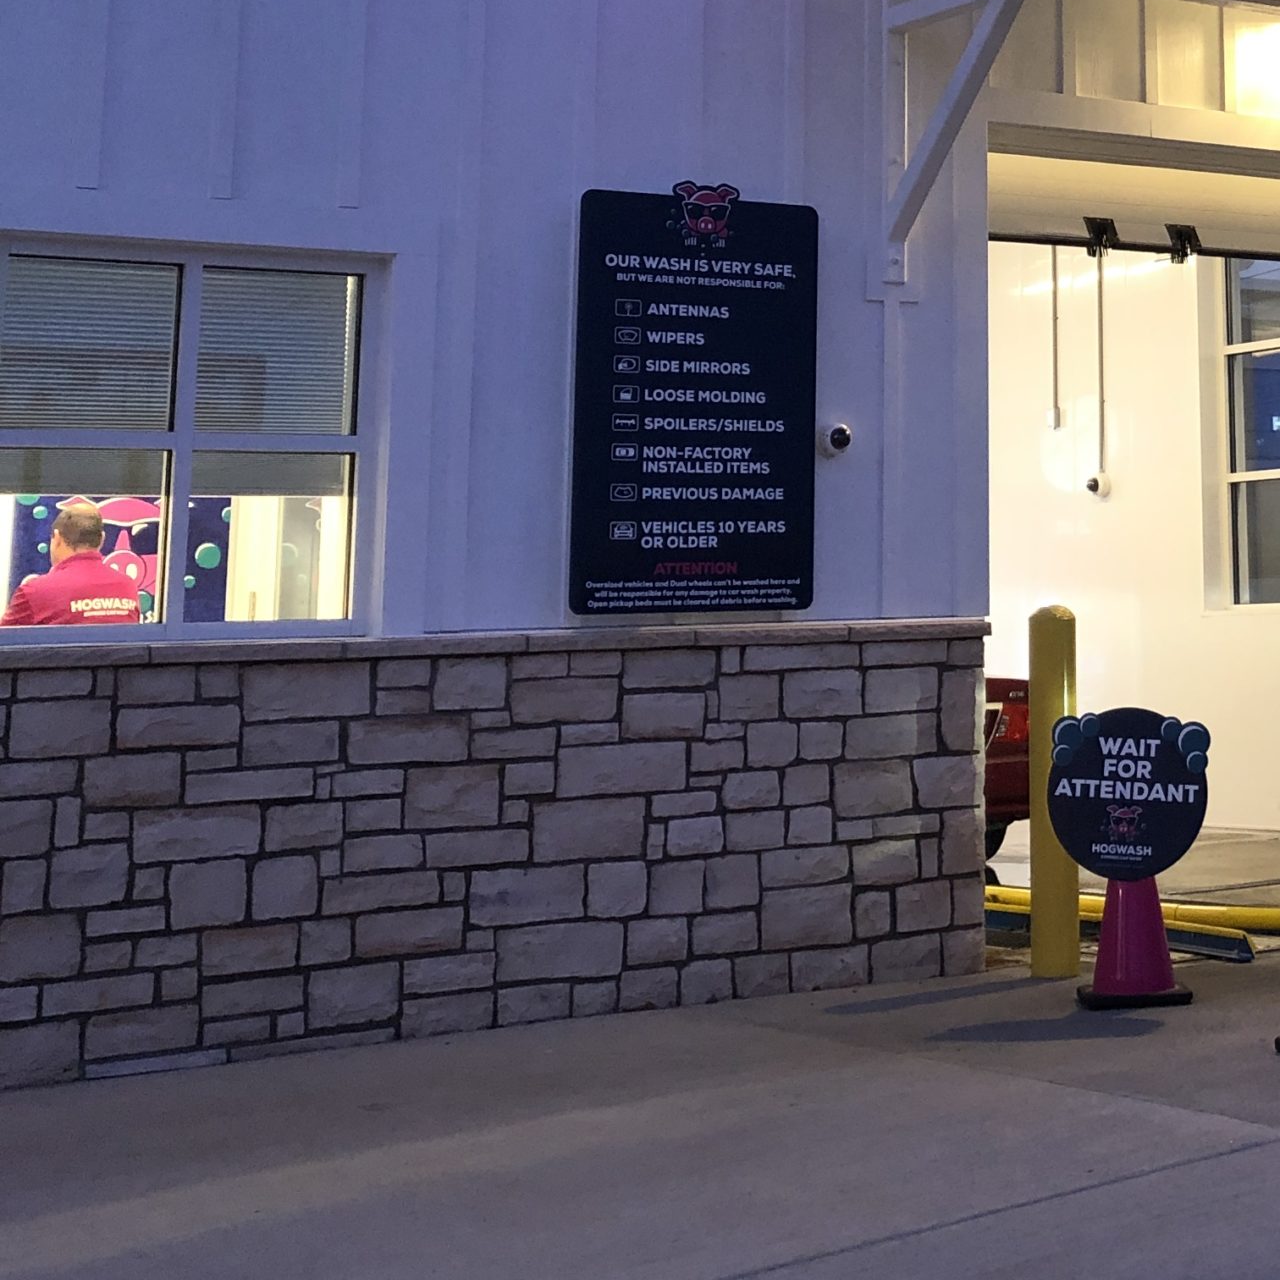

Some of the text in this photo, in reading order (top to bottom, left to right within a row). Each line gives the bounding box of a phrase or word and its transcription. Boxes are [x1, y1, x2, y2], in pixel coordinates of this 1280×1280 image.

[605, 253, 640, 268] OUR
[643, 255, 691, 271] WASH
[694, 259, 709, 272] IS
[711, 260, 752, 275] VERY
[616, 273, 635, 282] BUT
[638, 273, 653, 283] WE
[655, 274, 675, 284] ARE
[676, 275, 697, 285] NOT
[698, 277, 762, 289] RESPONSIBLE
[647, 303, 730, 318] ANTENNAS
[646, 330, 705, 345] WIPERS
[645, 359, 751, 375] SIDE MIRRORS
[644, 389, 767, 404] LOOSE MOLDING
[643, 417, 785, 432] SPOILERS/SHIELDS
[643, 446, 752, 460] NON-FACTORY
[642, 461, 770, 475] INSTALLED ITEMS
[642, 487, 784, 501] PREVIOUS DAMAGE
[641, 520, 786, 534] VEHICLES 10 YEARS
[641, 536, 718, 549] OR OLDER
[654, 561, 737, 575] ATTENTION
[624, 580, 653, 588] vehicles
[688, 579, 712, 587] wheels
[743, 578, 769, 586] washed
[787, 577, 800, 585] and
[620, 589, 661, 599] responsible
[675, 590, 688, 598] any
[689, 588, 718, 598] damage
[740, 587, 759, 595] wash
[70, 597, 137, 613] HOGWASH
[587, 600, 608, 609] Open
[609, 599, 634, 609] pickup
[1099, 736, 1161, 758] WAIT
[1103, 758, 1152, 779] FOR
[1054, 778, 1199, 803] ATTENDANT
[1091, 842, 1152, 856] HOGWASH
